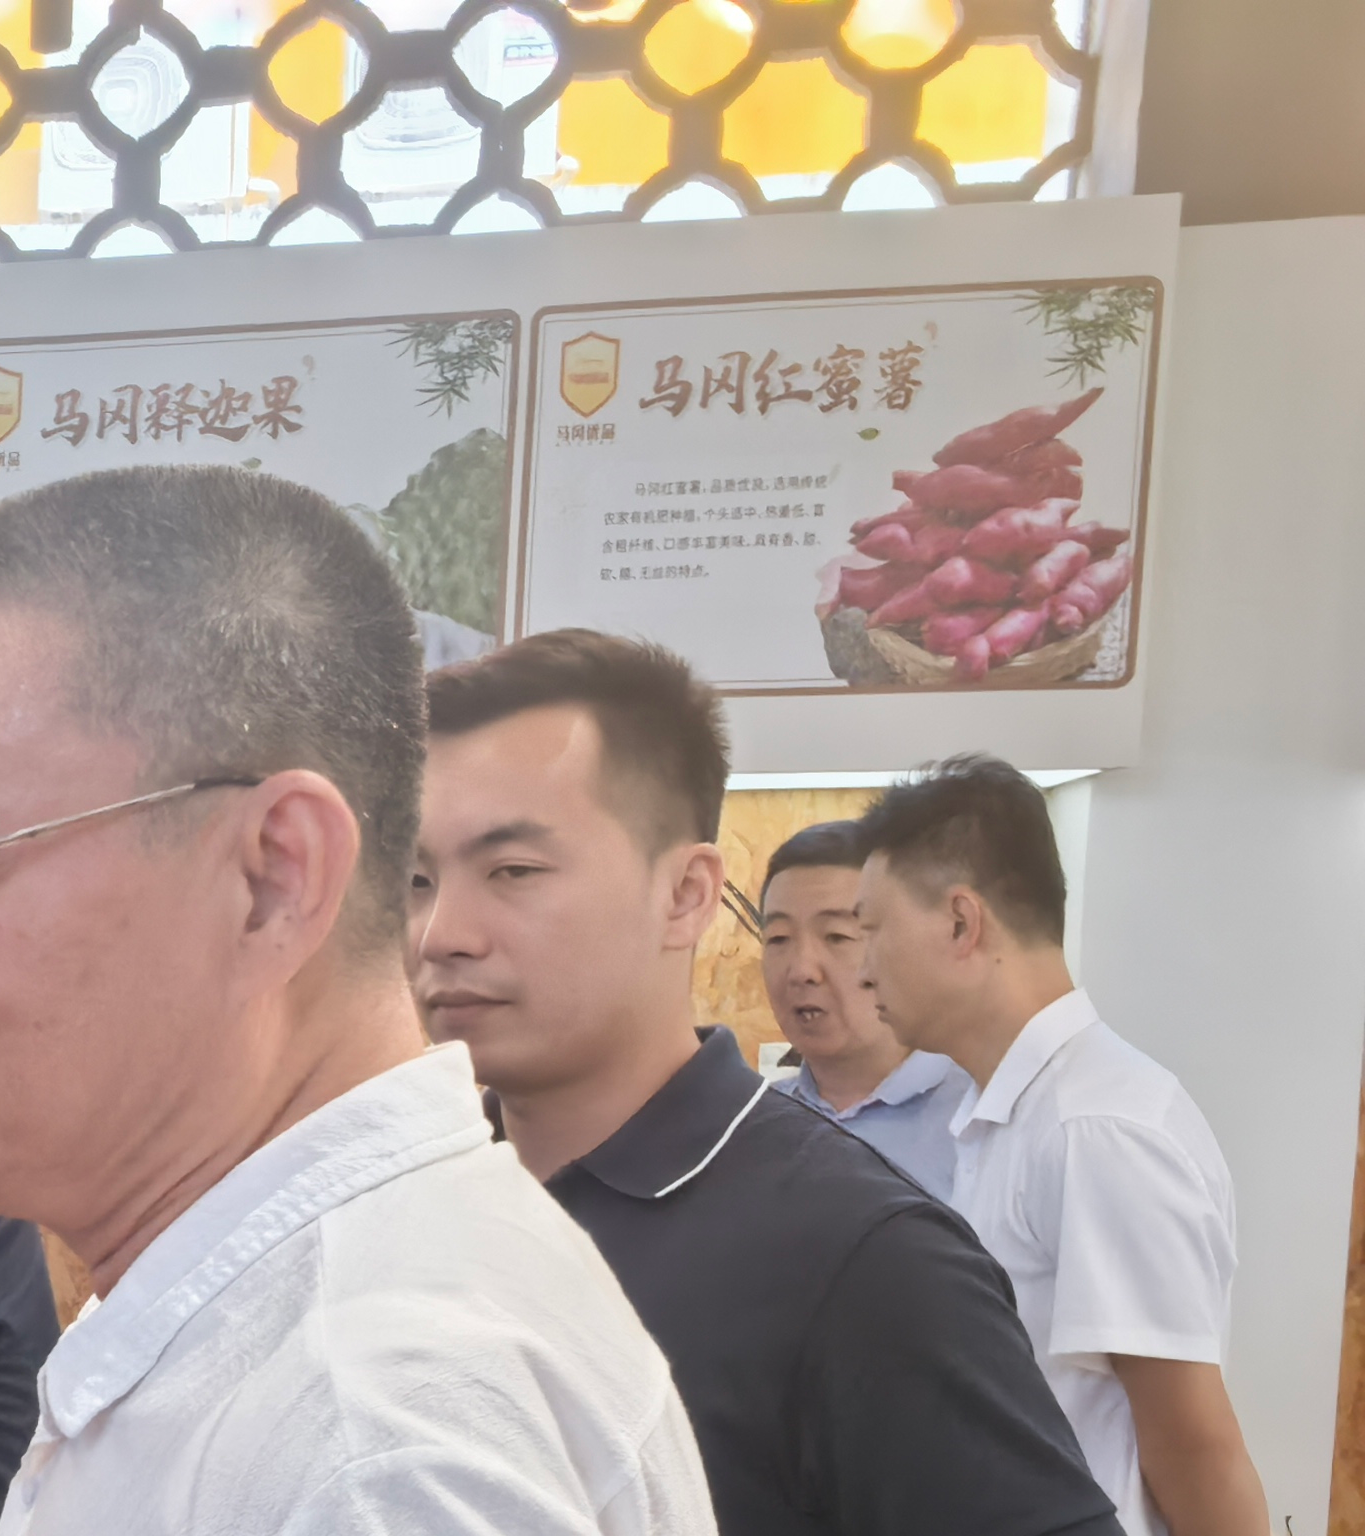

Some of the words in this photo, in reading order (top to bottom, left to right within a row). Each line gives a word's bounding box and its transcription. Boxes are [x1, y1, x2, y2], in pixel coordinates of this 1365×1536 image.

[41, 375, 302, 447] 马冈释迦果
[639, 340, 924, 417] 马冈红蜜薯
